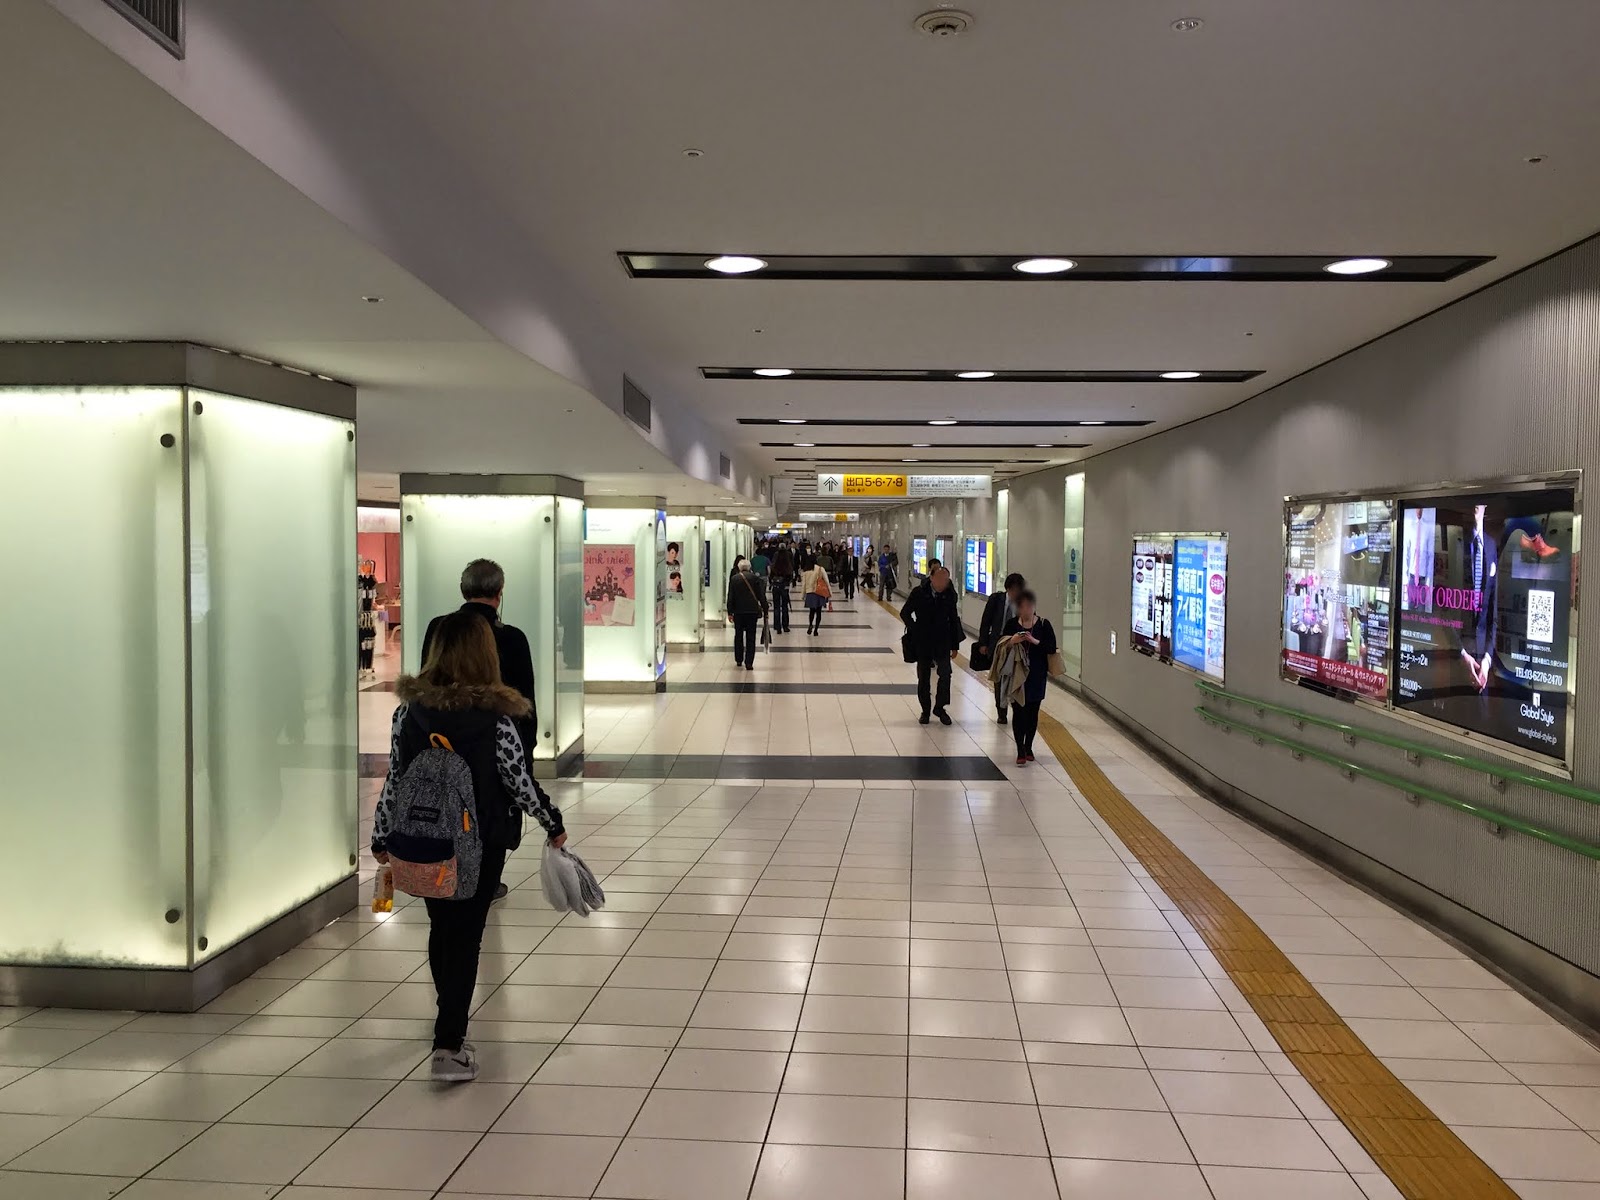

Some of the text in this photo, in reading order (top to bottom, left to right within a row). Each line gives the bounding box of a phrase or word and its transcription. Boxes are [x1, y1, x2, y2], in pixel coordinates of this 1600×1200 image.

[1401, 584, 1435, 608] ENJOY
[1520, 703, 1555, 727] Global Style
